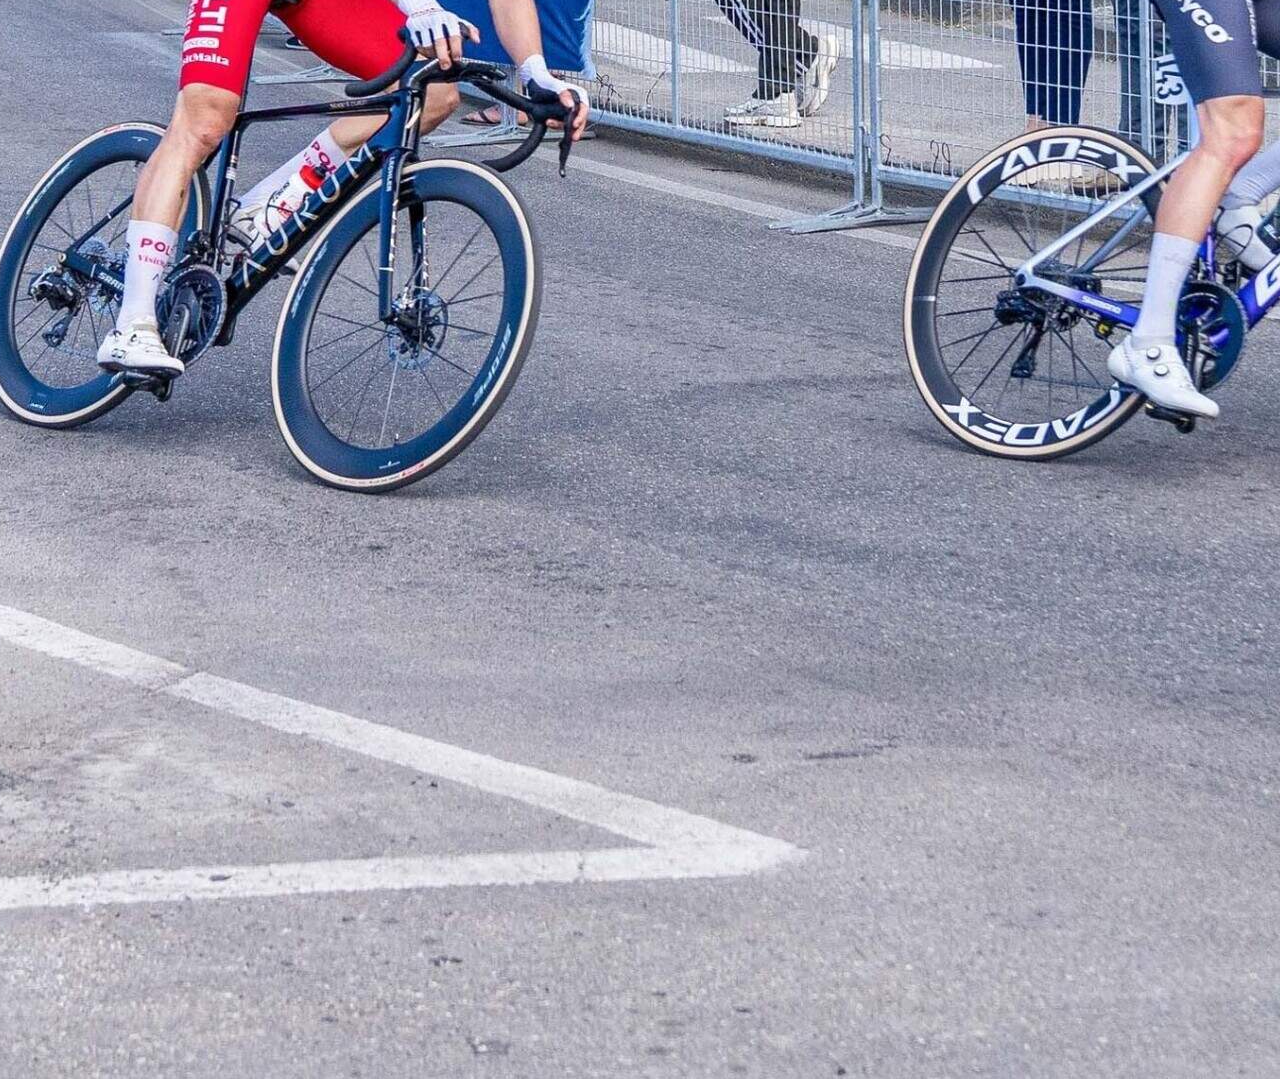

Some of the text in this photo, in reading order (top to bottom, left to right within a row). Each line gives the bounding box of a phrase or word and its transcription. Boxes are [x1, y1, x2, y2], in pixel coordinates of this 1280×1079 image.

[310, 140, 338, 175] POL
[967, 136, 1148, 205] CADEX
[140, 237, 174, 257] POL
[240, 142, 376, 289] AURUM
[942, 380, 1120, 446] CADEX
